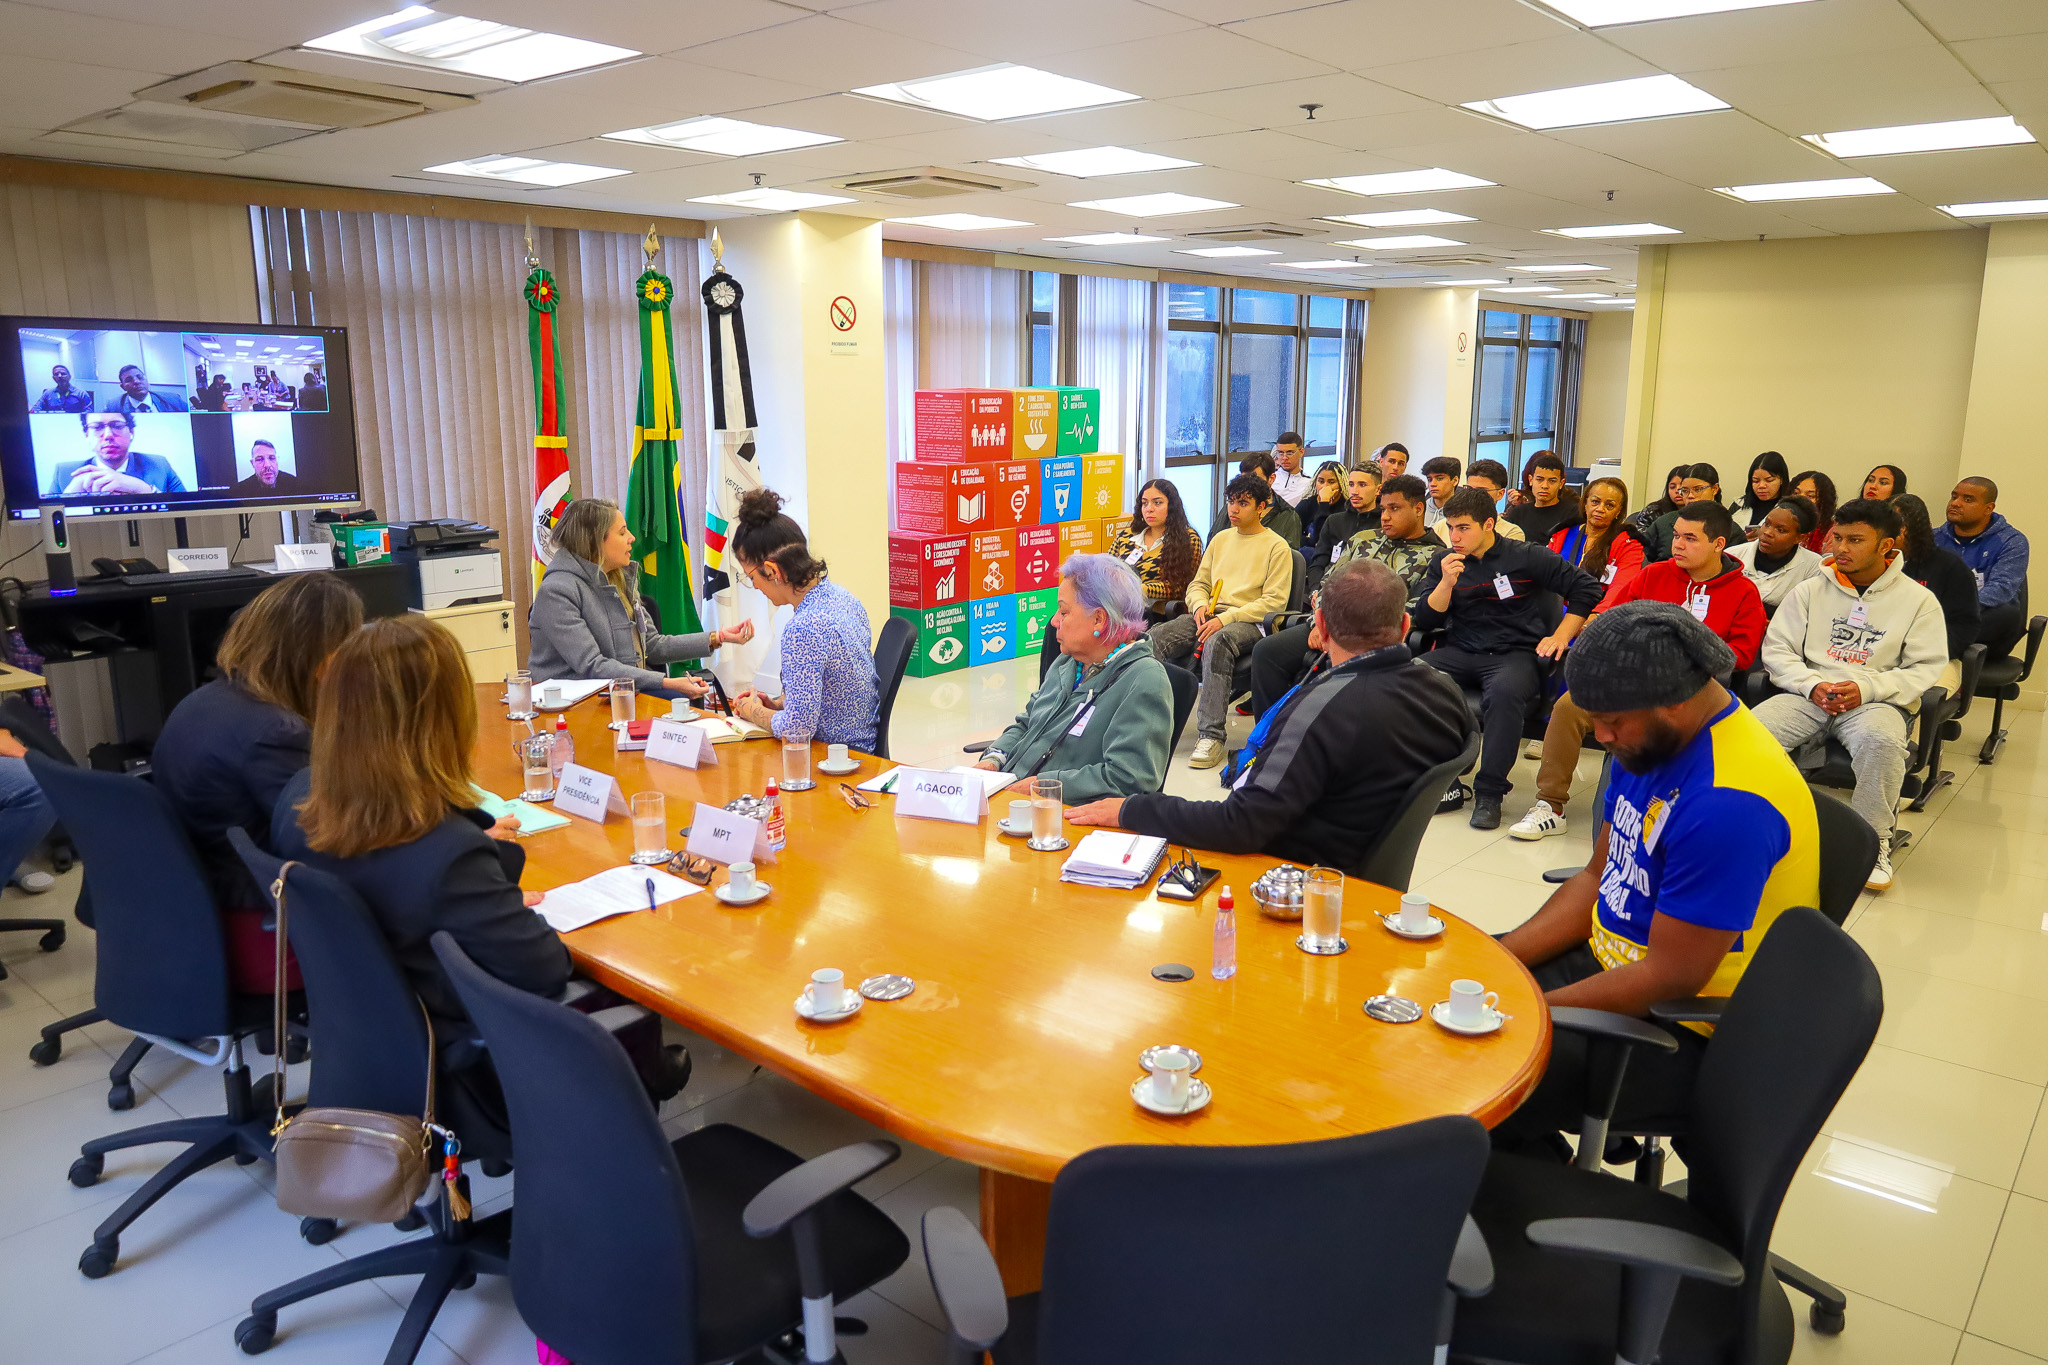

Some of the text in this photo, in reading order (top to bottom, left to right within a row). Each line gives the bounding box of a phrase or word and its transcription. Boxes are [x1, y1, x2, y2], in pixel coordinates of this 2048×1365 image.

[971, 398, 976, 414] 1
[1019, 397, 1025, 412] 2
[1062, 395, 1068, 410] 3
[960, 468, 980, 477] EDUCAÇÃO
[999, 467, 1005, 482] 5
[1044, 464, 1051, 479] 6
[1087, 461, 1092, 475] 7
[951, 470, 958, 485] 4
[1061, 527, 1069, 541] 11
[1106, 523, 1114, 537] 12
[974, 537, 981, 553] 9
[1018, 531, 1028, 547] 10
[177, 553, 219, 561] CORREIOS
[924, 544, 932, 560] 8
[973, 604, 983, 619] 14
[1018, 596, 1027, 612] 15
[924, 613, 935, 629] 13
[662, 730, 688, 745] SINTEC
[578, 774, 593, 786] VICE
[563, 784, 600, 806] PRESIDÊNCIA
[915, 782, 964, 798] AGACOR
[713, 827, 731, 842] MPT
